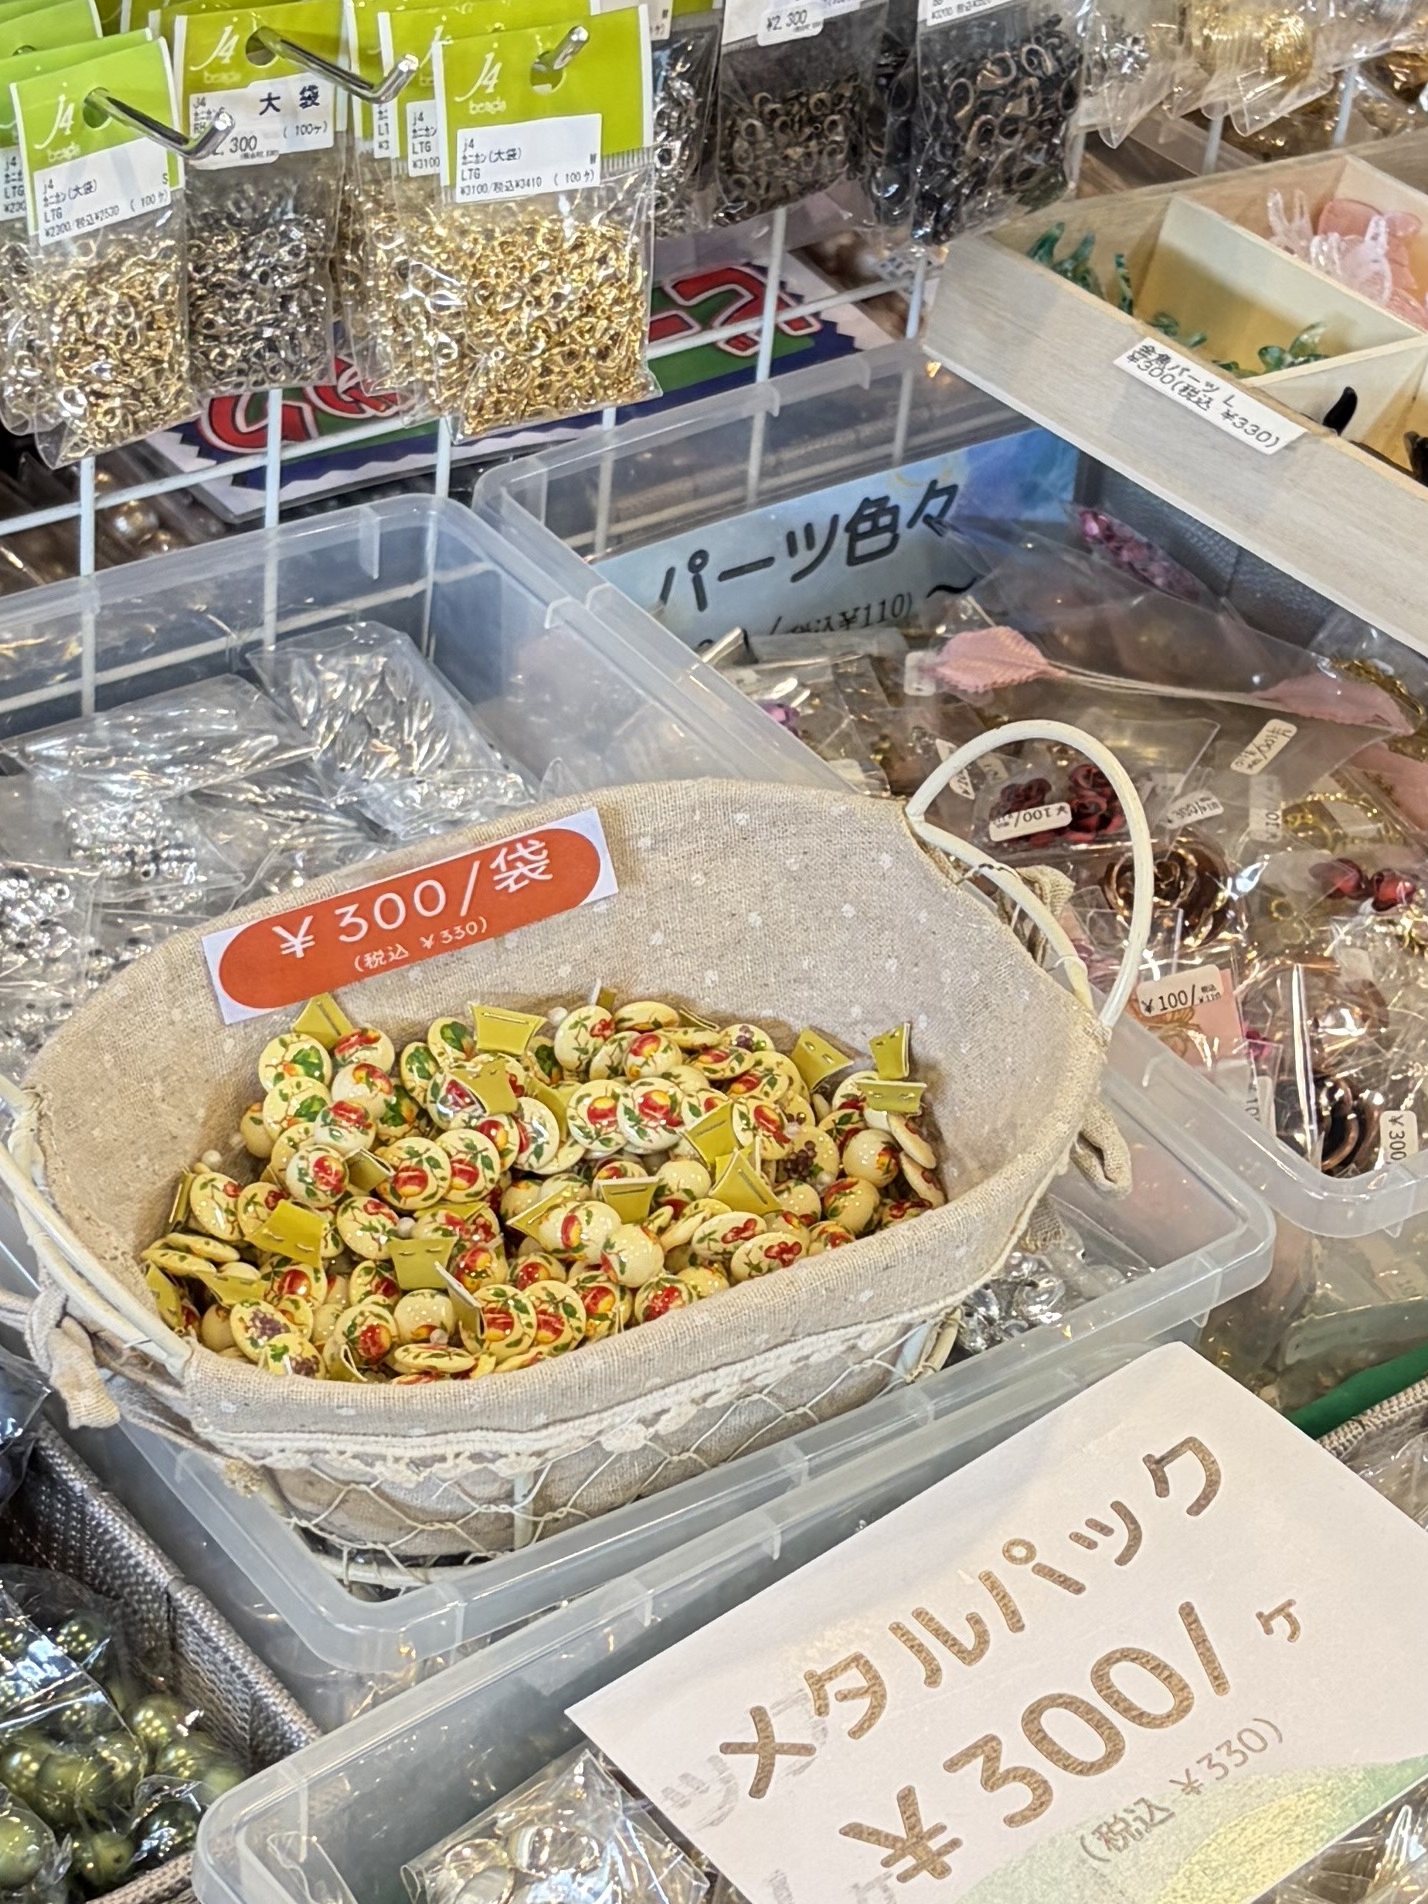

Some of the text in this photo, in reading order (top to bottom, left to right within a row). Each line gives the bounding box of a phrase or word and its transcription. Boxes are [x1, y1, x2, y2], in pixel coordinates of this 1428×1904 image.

[1221, 408, 1280, 448] ¥330)
[660, 480, 959, 611] パーツ色々
[718, 1433, 1224, 1800] メタルパック
